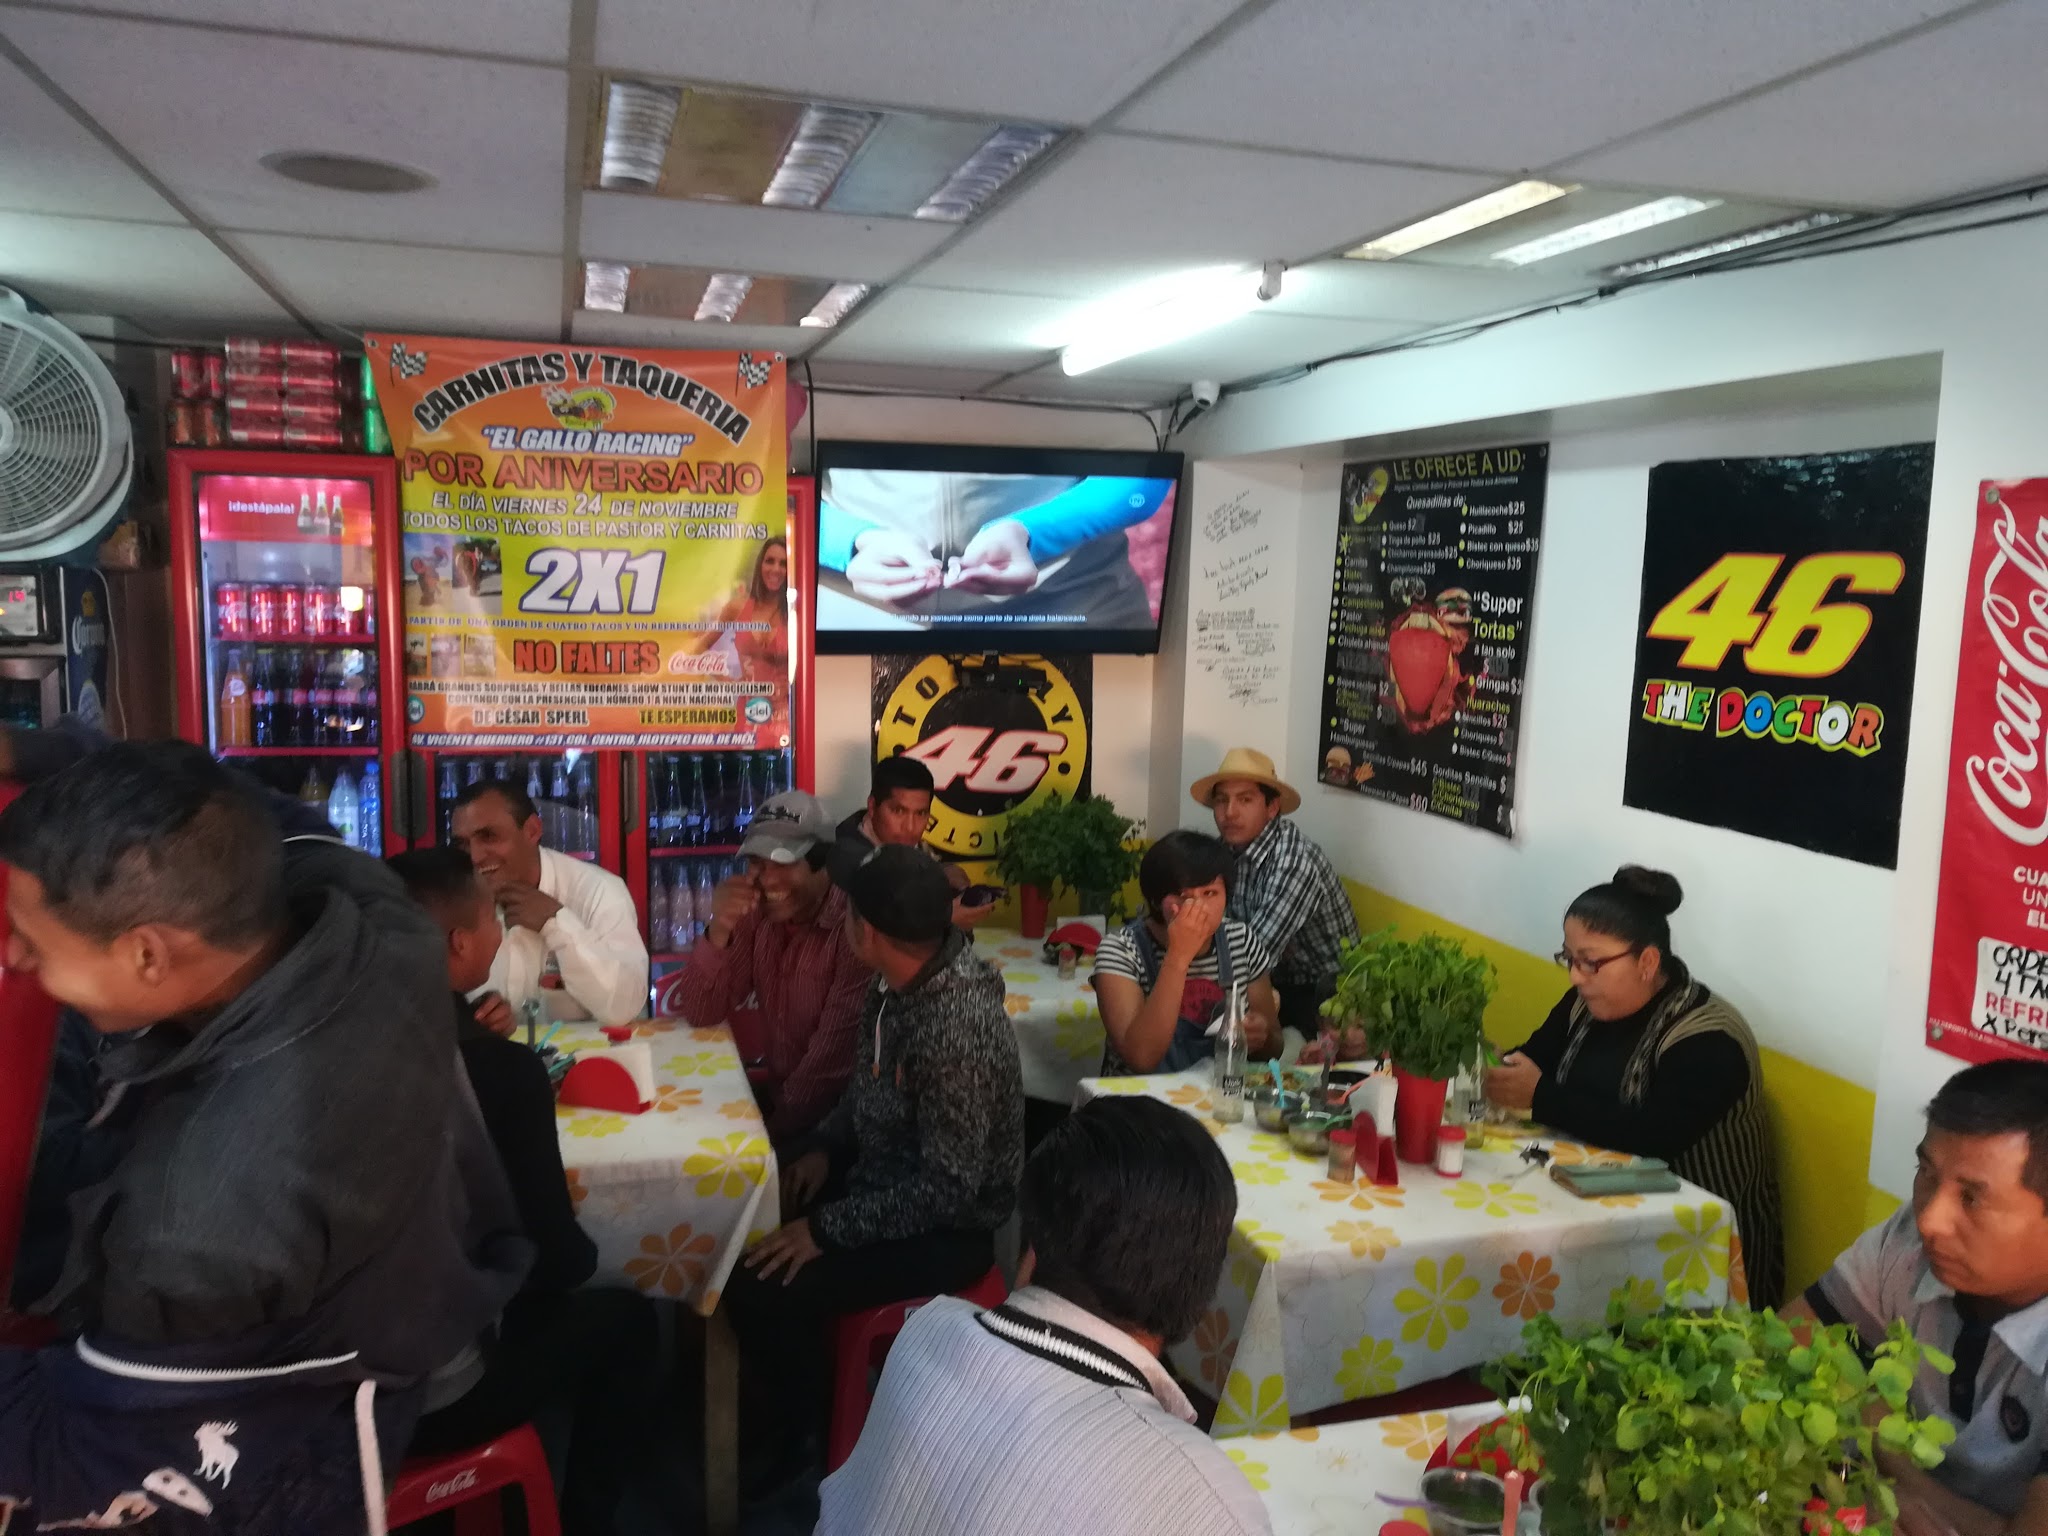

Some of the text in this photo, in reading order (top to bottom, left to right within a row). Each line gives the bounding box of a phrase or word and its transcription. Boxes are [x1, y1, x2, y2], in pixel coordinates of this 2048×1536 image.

[411, 351, 568, 433] CARNITAS
[570, 350, 595, 383] Y
[598, 354, 752, 447] TAQUERIA
[520, 428, 591, 453] GALLO
[404, 449, 764, 495] POR ANIVERSARIO
[1393, 459, 1412, 481] LE
[1414, 452, 1478, 480] OFRECE
[1481, 451, 1493, 475] A
[432, 491, 739, 519] EL DÍA VIERNES 24 DE NOVIEMBRE
[1406, 494, 1451, 510] Quesadillas
[404, 511, 768, 540] TODOS LOS TACOS DE PASTOR Y CARNITAS
[518, 547, 666, 615] 2X1
[492, 619, 527, 629] ORDEN
[530, 621, 543, 630] DE
[546, 620, 588, 631] CUATRO
[591, 622, 623, 631] TACOS
[634, 622, 648, 631] UN
[651, 622, 703, 632] REFRESCO
[1645, 551, 1906, 679] 46
[513, 640, 660, 674] NO FALTES
[484, 683, 539, 693] SORPRESAS
[632, 684, 659, 694] SHOW
[1476, 674, 1510, 694] Gringas
[474, 710, 492, 724] DE
[495, 708, 539, 724] CÉSAR
[640, 709, 737, 724] TE ESPERAMOS
[1643, 679, 1884, 756] THE DOCTOR
[427, 733, 474, 746] VICENTE
[474, 733, 534, 746] GUERRERO
[900, 725, 1068, 793] 46
[1995, 969, 2012, 996] 4
[1985, 991, 2048, 1029] REFR
